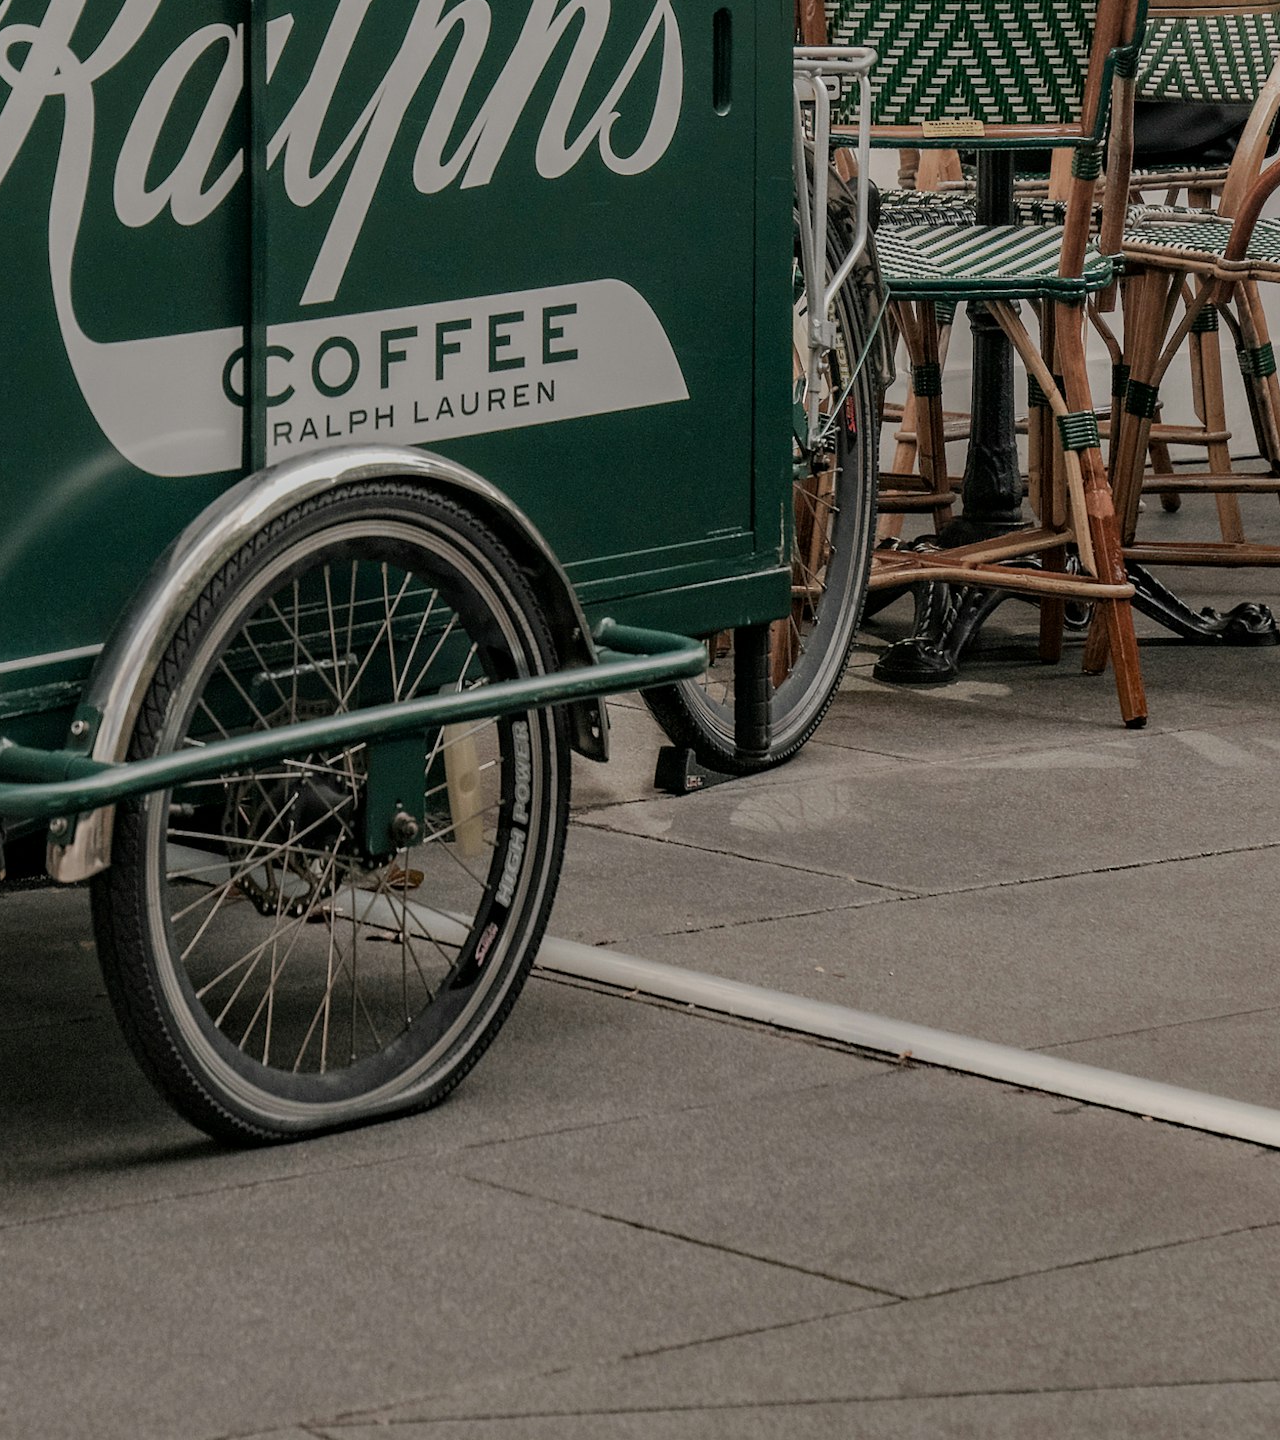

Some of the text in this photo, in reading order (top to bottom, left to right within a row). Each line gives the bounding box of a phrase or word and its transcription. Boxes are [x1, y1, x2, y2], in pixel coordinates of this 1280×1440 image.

[221, 301, 579, 408] COFFEE
[272, 378, 557, 447] RALPH LAUREN
[494, 720, 532, 909] HIGH POWER
